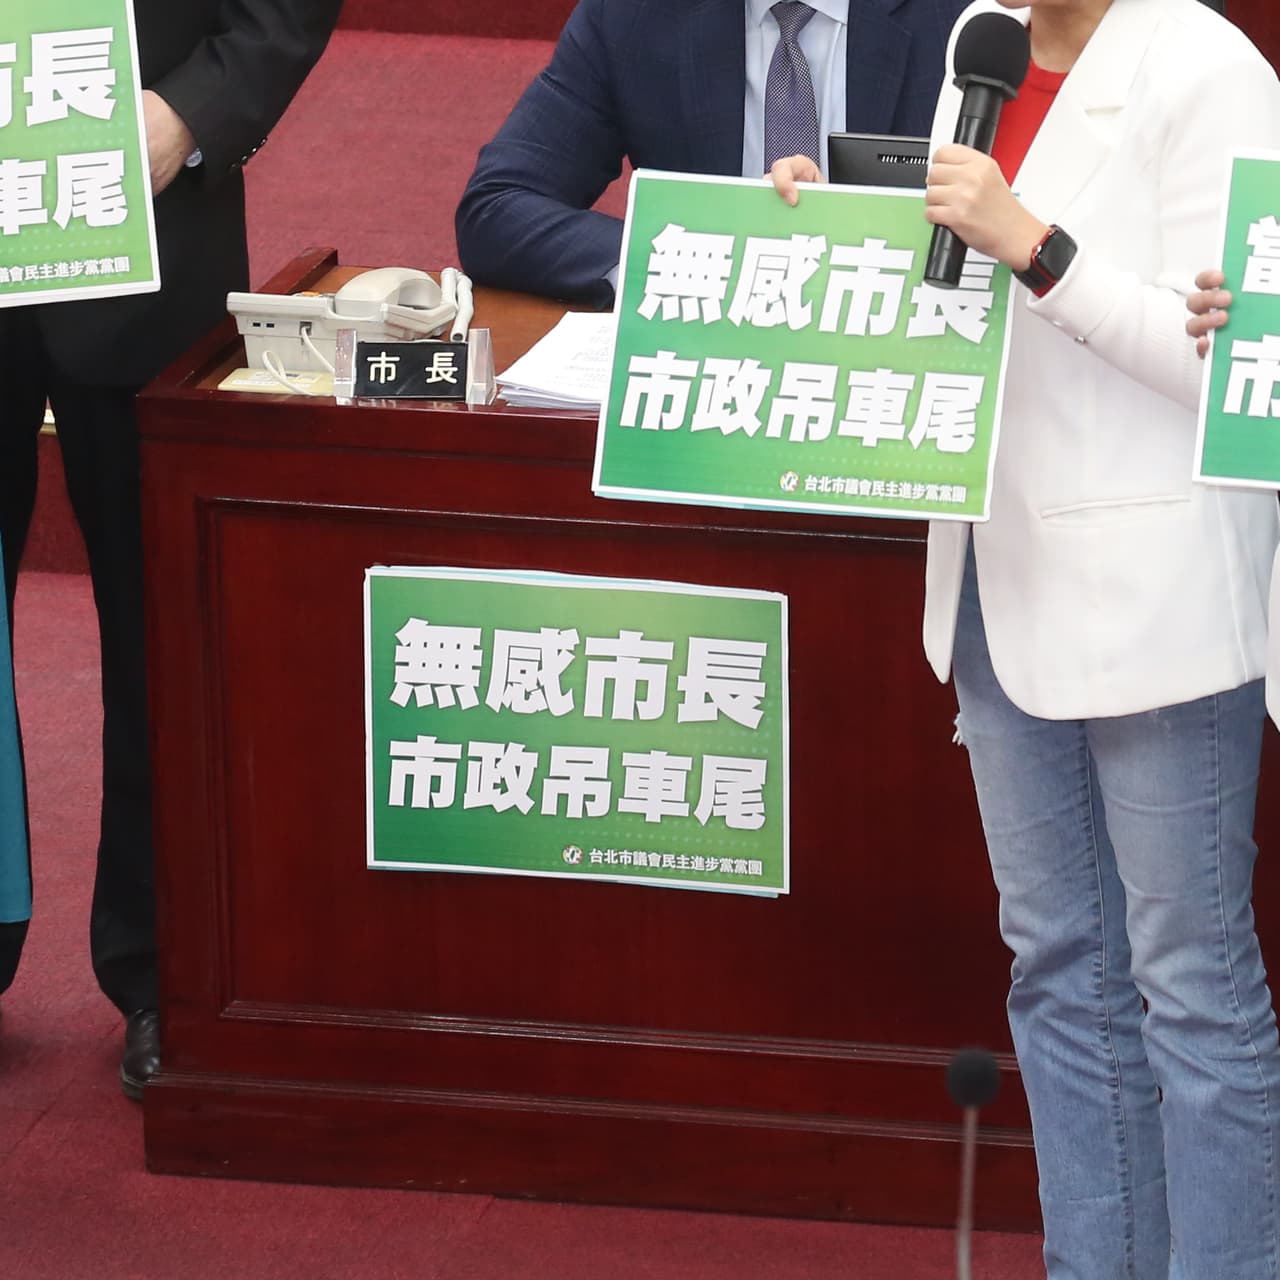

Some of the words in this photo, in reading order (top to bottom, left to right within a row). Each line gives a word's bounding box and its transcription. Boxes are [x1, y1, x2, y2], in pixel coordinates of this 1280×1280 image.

[637, 223, 999, 343] 無感市長
[366, 350, 459, 384] 市長
[620, 350, 985, 453] 市政吊車尾
[805, 475, 967, 503] 台北市議會民主進步黨黨團
[390, 618, 768, 729] 無感市長
[388, 735, 767, 830] 市政吊車尾
[590, 849, 762, 875] 台北市議會民主進步黨黨團
